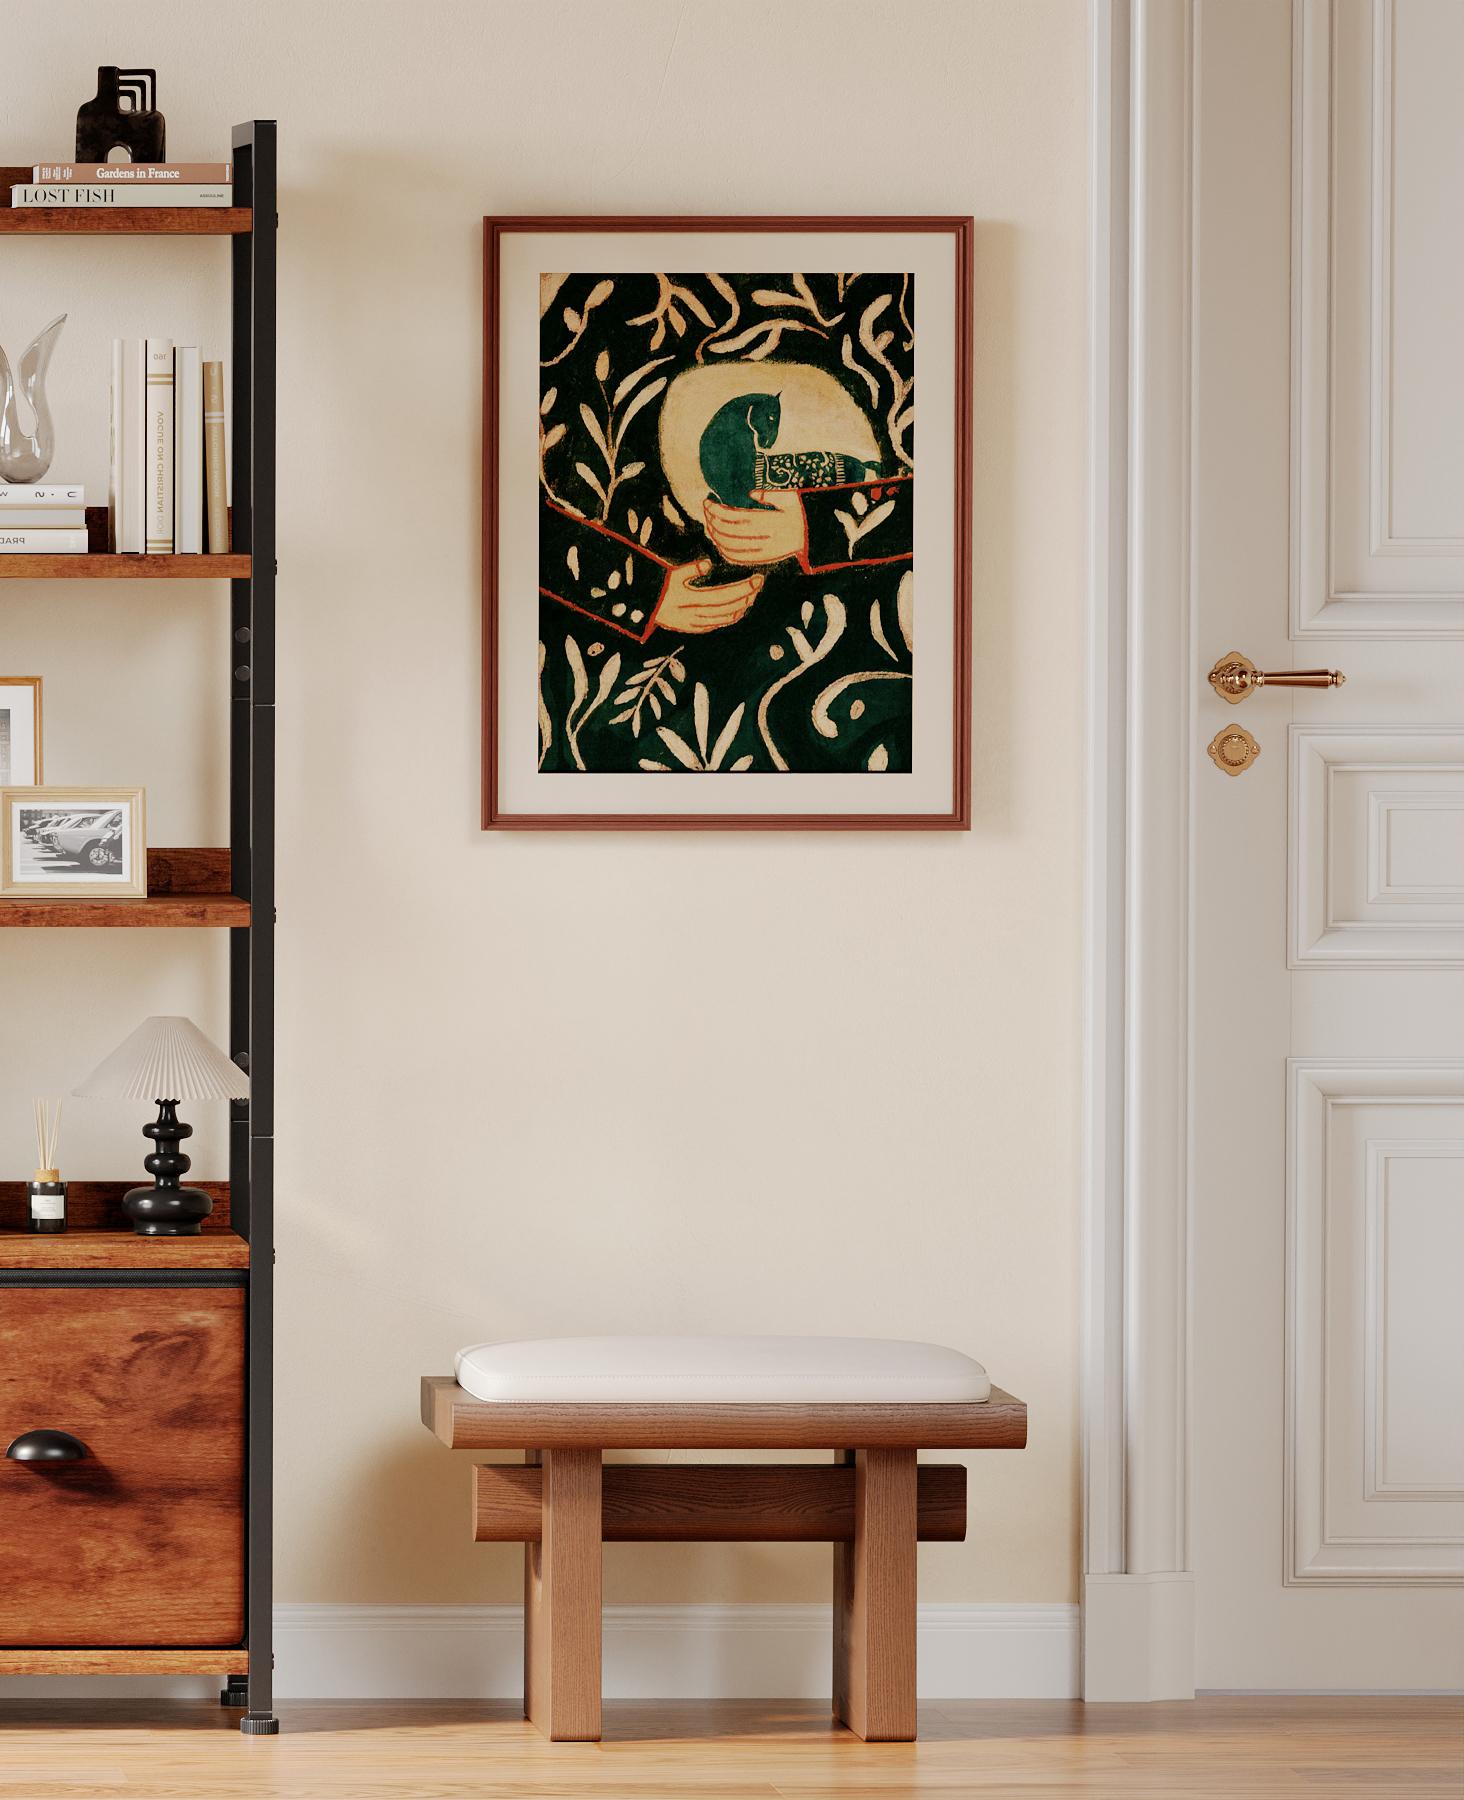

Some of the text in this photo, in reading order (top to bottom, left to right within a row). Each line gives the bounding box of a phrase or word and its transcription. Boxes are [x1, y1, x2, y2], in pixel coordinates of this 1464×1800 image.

[95, 167, 180, 179] Gardens in France
[24, 189, 115, 203] LOST FISH
